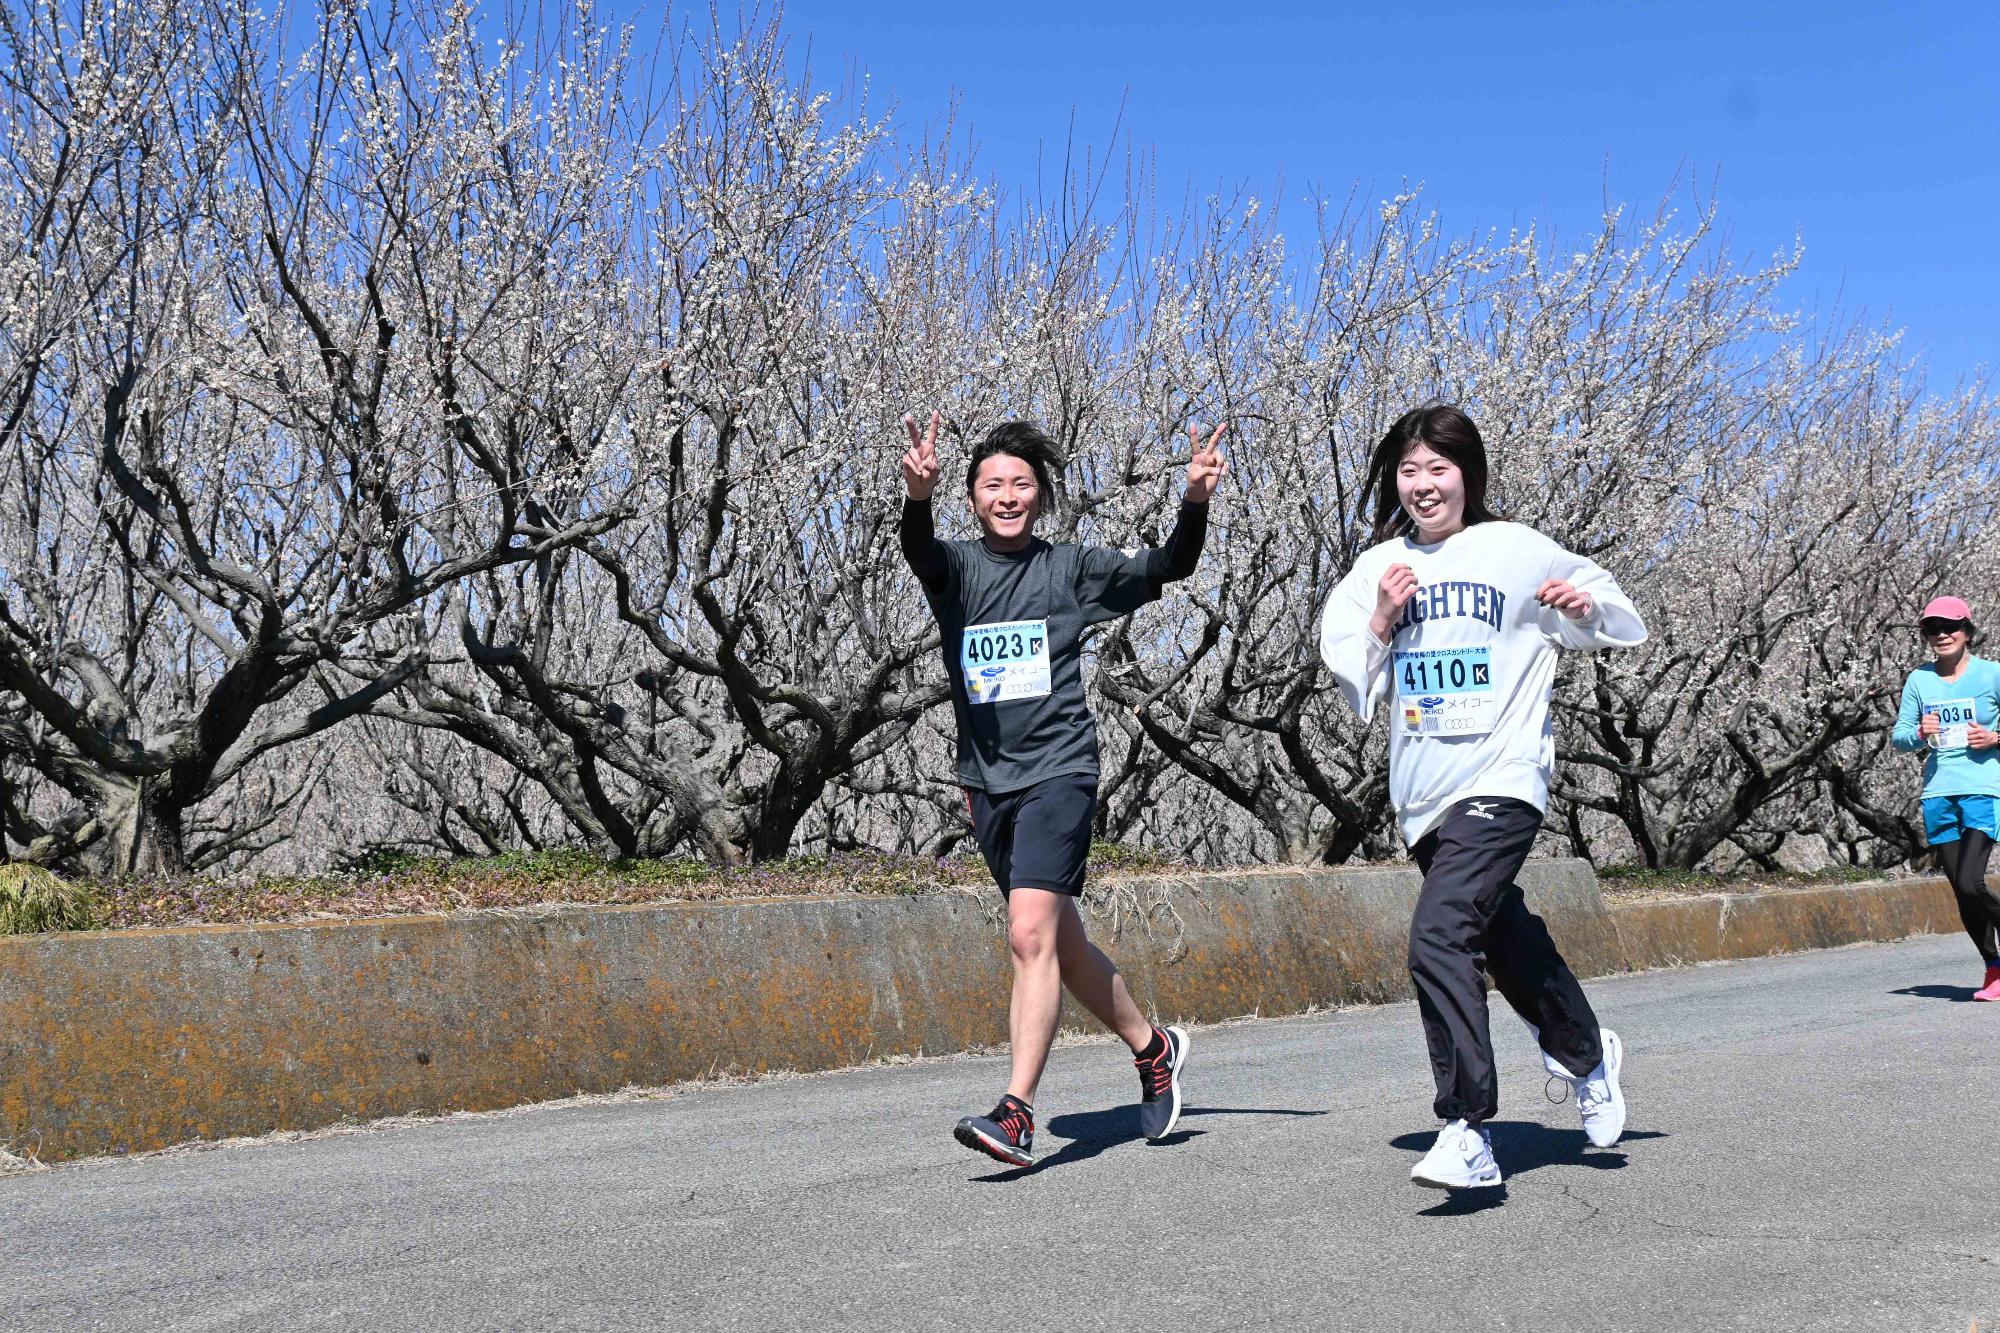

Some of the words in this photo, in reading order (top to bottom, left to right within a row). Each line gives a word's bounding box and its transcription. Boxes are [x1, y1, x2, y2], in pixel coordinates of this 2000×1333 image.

[1391, 581, 1505, 640] IGHTEN
[968, 633, 1023, 663] 4023
[1031, 639, 1042, 654] K
[1009, 666, 1047, 676] メイコー
[1405, 659, 1466, 690] 4110
[1474, 666, 1488, 683] K
[1447, 698, 1493, 709] メイコー
[1928, 707, 1960, 723] 03
[1465, 809, 1494, 819] MIZUNO
